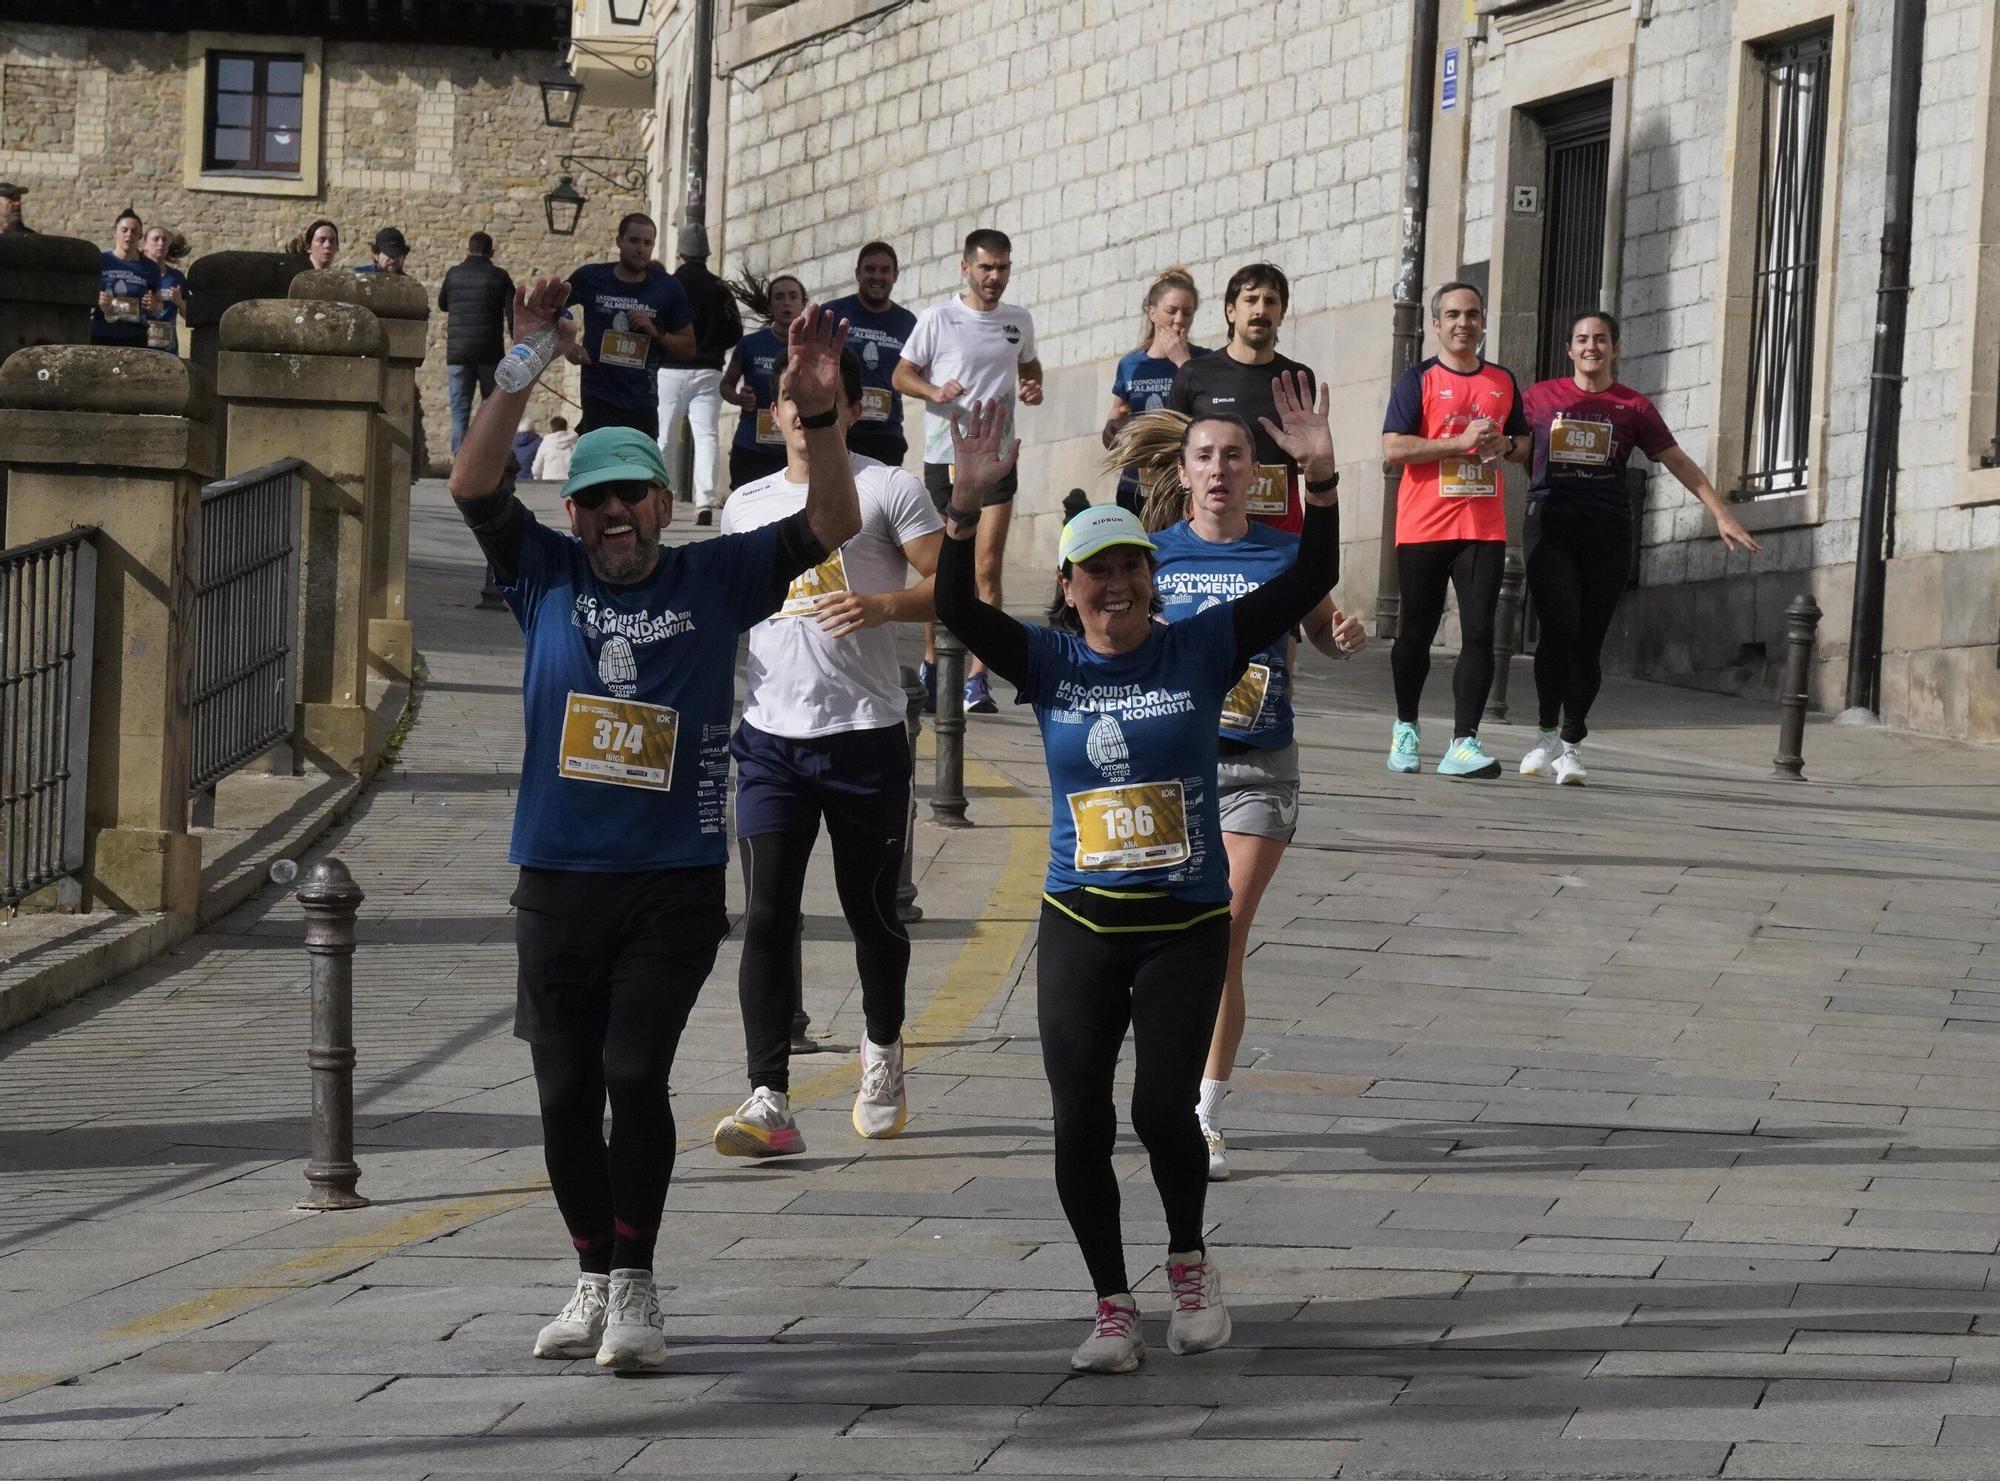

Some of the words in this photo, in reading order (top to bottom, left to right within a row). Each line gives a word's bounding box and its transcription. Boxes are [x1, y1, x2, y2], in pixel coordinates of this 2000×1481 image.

[603, 301, 650, 311] ALMENDRA
[1565, 431, 1595, 448] 458
[1457, 463, 1482, 480] 461
[1092, 517, 1123, 526] KIPRUN
[1157, 574, 1171, 584] LA
[1172, 572, 1245, 583] CONQUISTA
[1175, 581, 1265, 594] ALMENDR
[632, 620, 696, 644] KONKISTA
[1249, 671, 1263, 680] 10K
[1058, 680, 1071, 691] LA
[1122, 699, 1196, 721] KONKISTA
[656, 714, 671, 724] 10K
[592, 719, 644, 755] 374
[1100, 763, 1131, 772] VITORIA
[1101, 769, 1132, 778] GASTEIZ
[1161, 789, 1176, 799] 10K
[1101, 805, 1155, 840] 136
[1123, 841, 1138, 849] ANA
